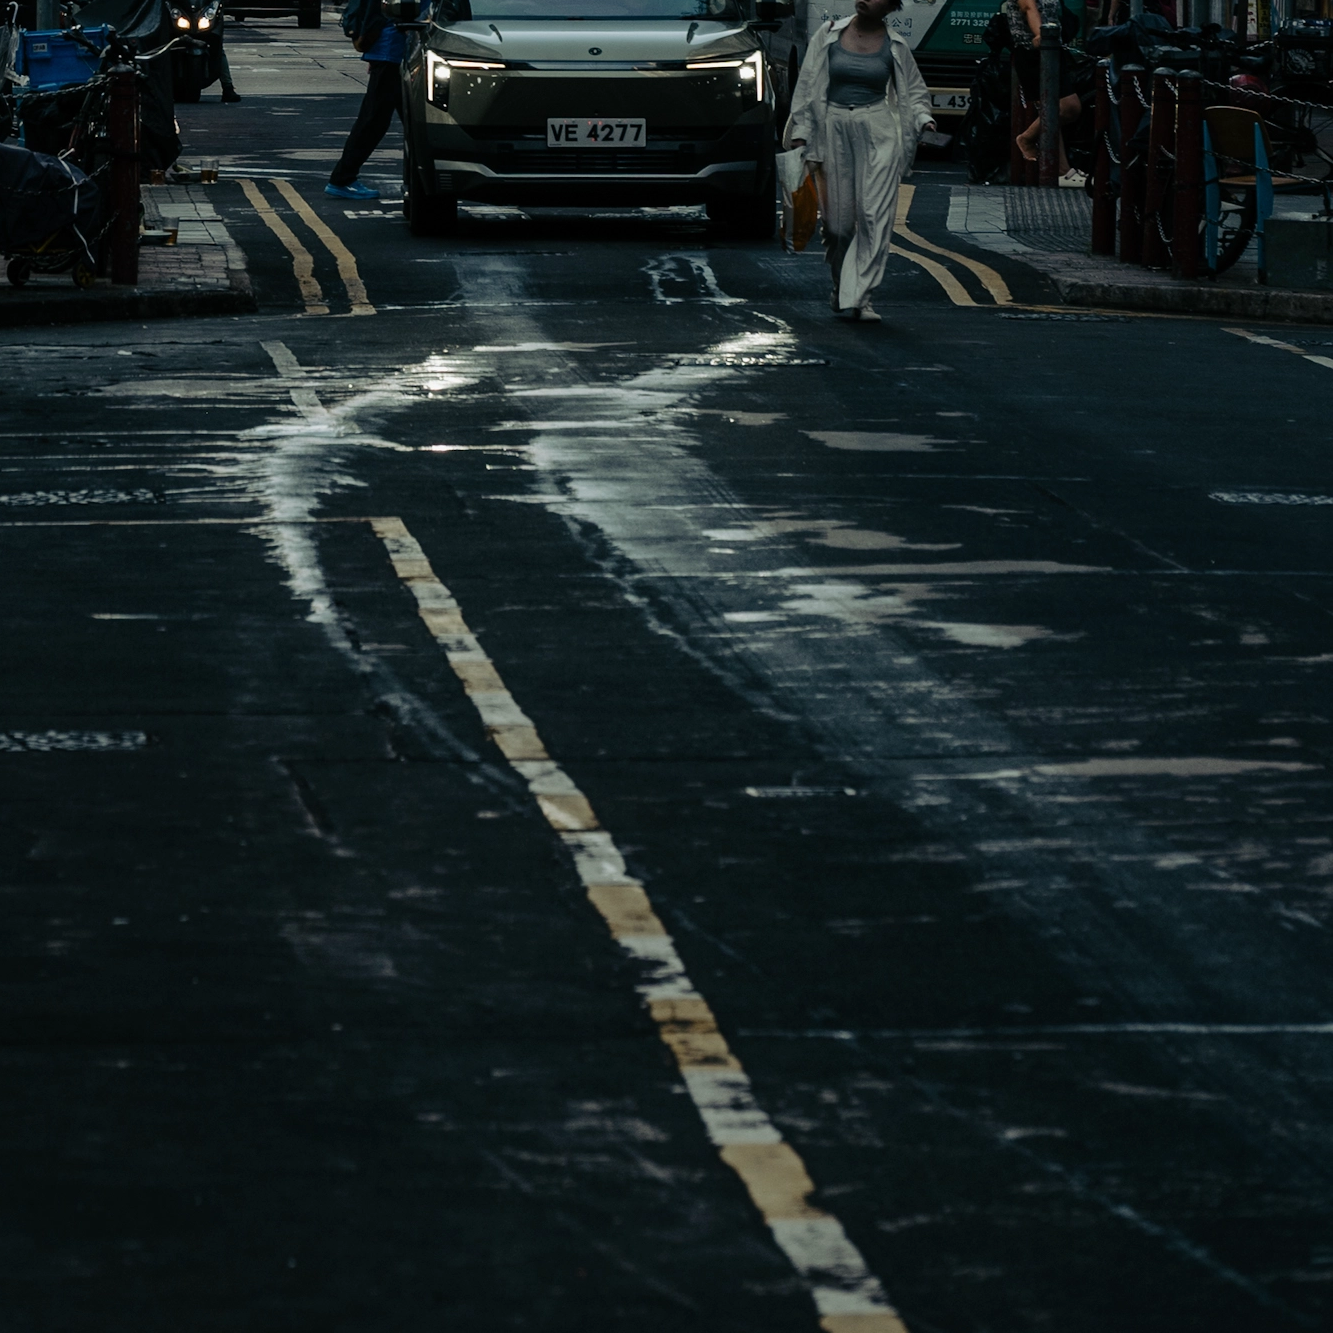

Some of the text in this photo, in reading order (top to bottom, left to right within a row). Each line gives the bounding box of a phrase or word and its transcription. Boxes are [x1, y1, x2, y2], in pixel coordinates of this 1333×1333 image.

[950, 18, 971, 26] 2771
[550, 124, 643, 142] VE 4277
